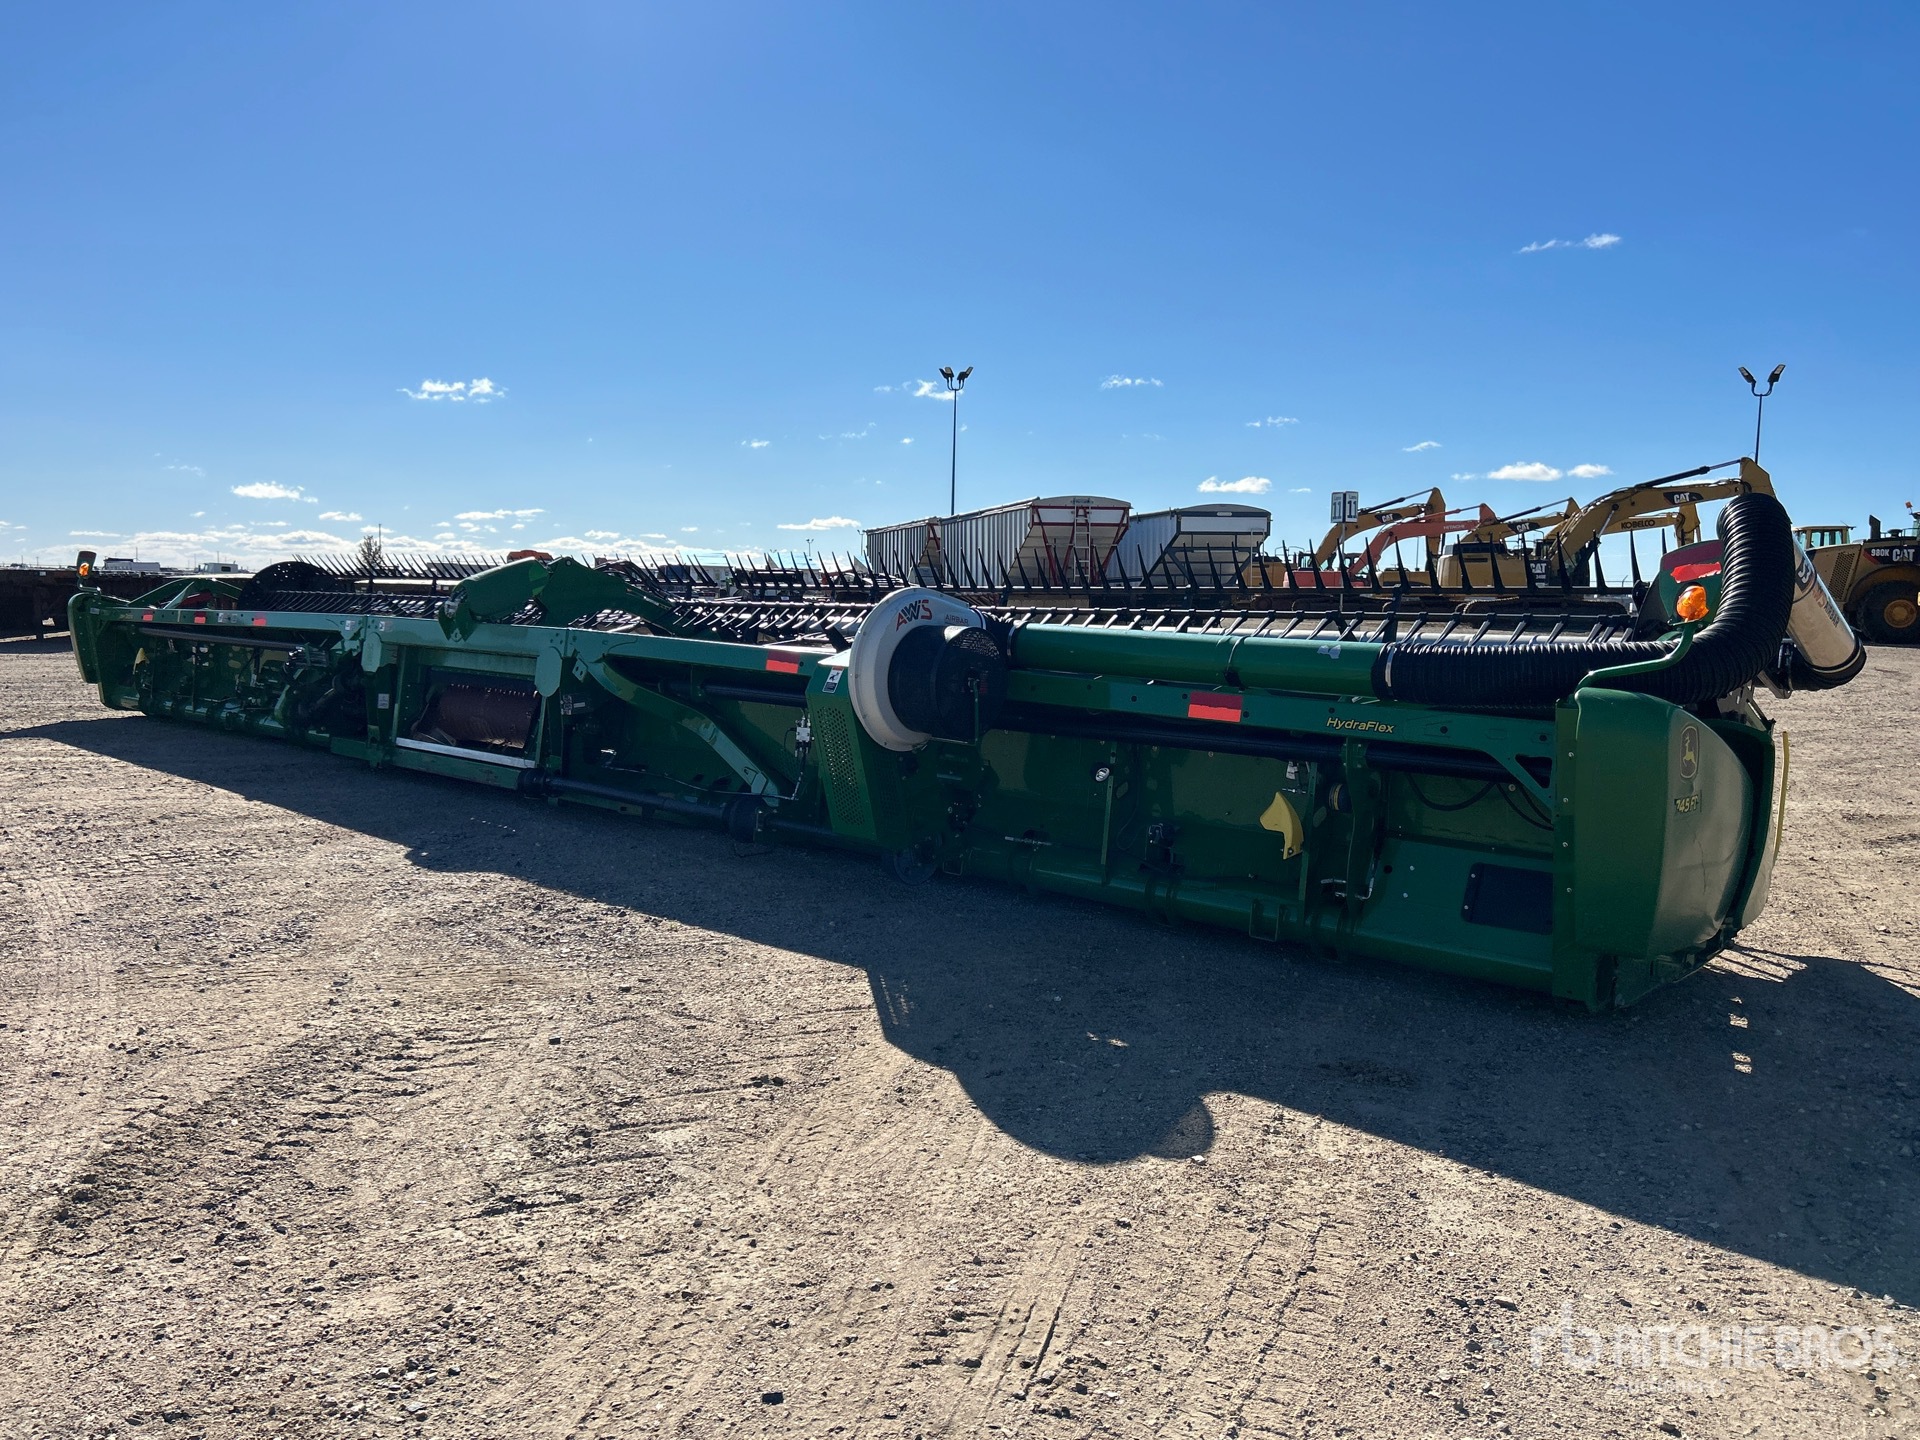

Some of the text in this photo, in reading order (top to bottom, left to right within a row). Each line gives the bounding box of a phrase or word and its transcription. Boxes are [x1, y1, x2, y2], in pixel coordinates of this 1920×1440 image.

[1674, 493, 1690, 504] CAT
[1332, 501, 1342, 519] 11
[1347, 500, 1357, 518] 11
[1381, 514, 1394, 522] CAT
[1516, 522, 1530, 533] CAT
[1621, 519, 1656, 530] KOBELCO
[1871, 548, 1915, 562] 980K CAT
[1530, 562, 1547, 574] CAT
[1326, 717, 1395, 733] HydraFlex
